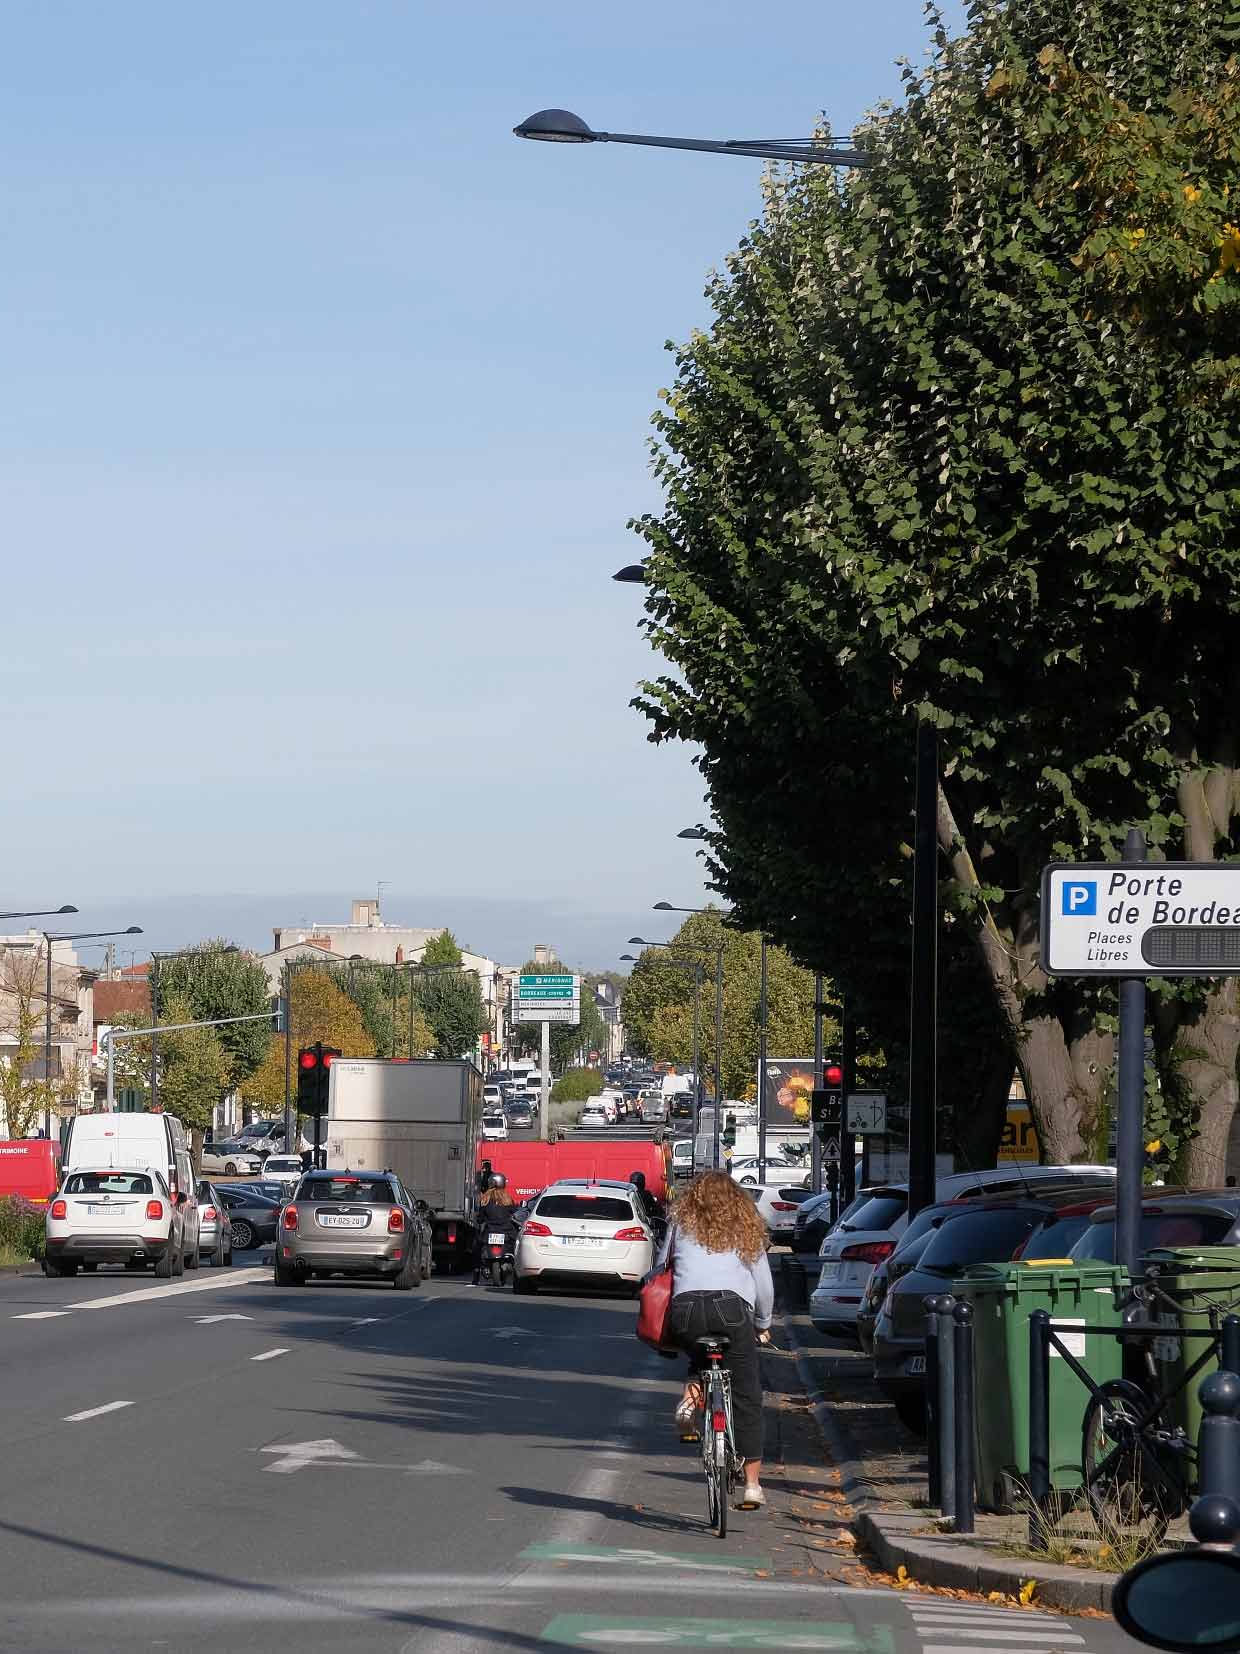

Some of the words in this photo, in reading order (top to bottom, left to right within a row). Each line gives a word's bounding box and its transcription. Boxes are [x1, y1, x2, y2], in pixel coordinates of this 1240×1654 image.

[1108, 873, 1183, 896] Porte
[1070, 887, 1089, 911] P
[1108, 901, 1140, 924] de
[1088, 932, 1133, 943] Places
[1088, 949, 1129, 960] Libres
